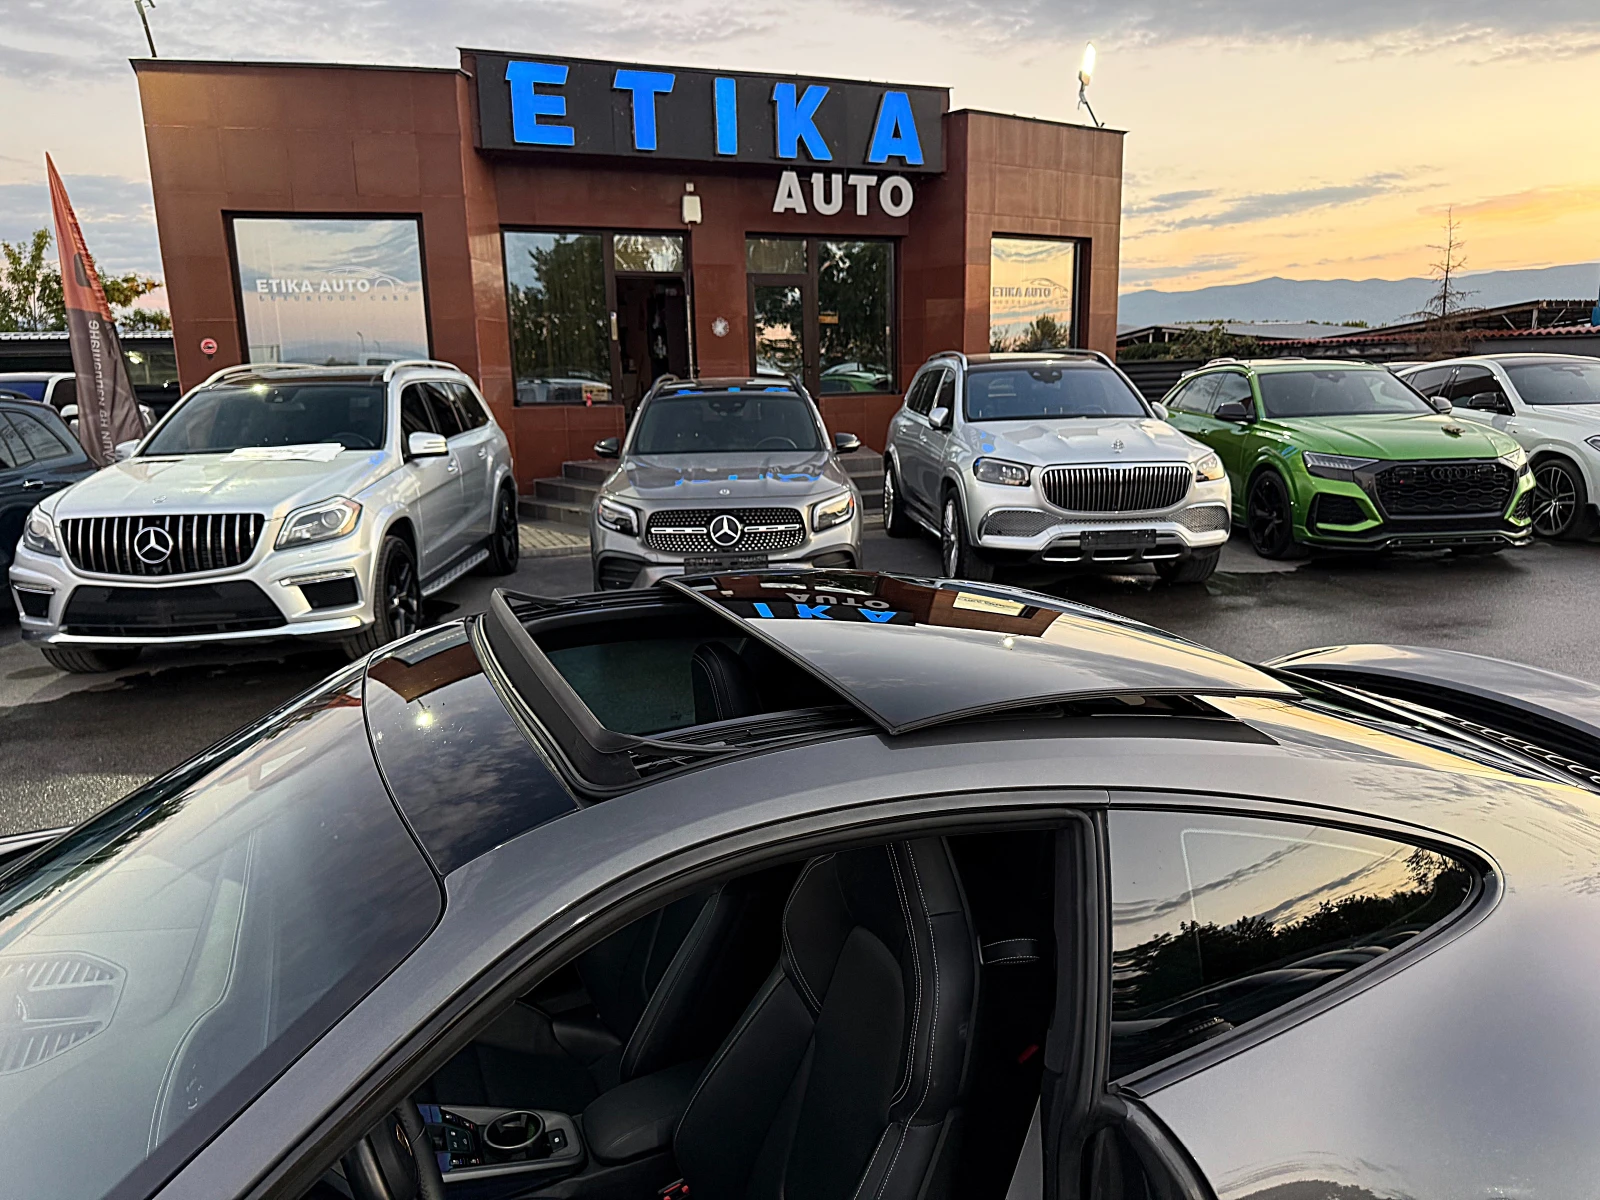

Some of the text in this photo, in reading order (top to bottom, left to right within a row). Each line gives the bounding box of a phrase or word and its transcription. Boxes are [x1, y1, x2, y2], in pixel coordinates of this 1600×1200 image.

[505, 60, 925, 165] ETIKA
[772, 170, 914, 217] AUTO
[255, 278, 371, 293] ETIKA AUTO
[992, 286, 1052, 298] ETIKA AUTO
